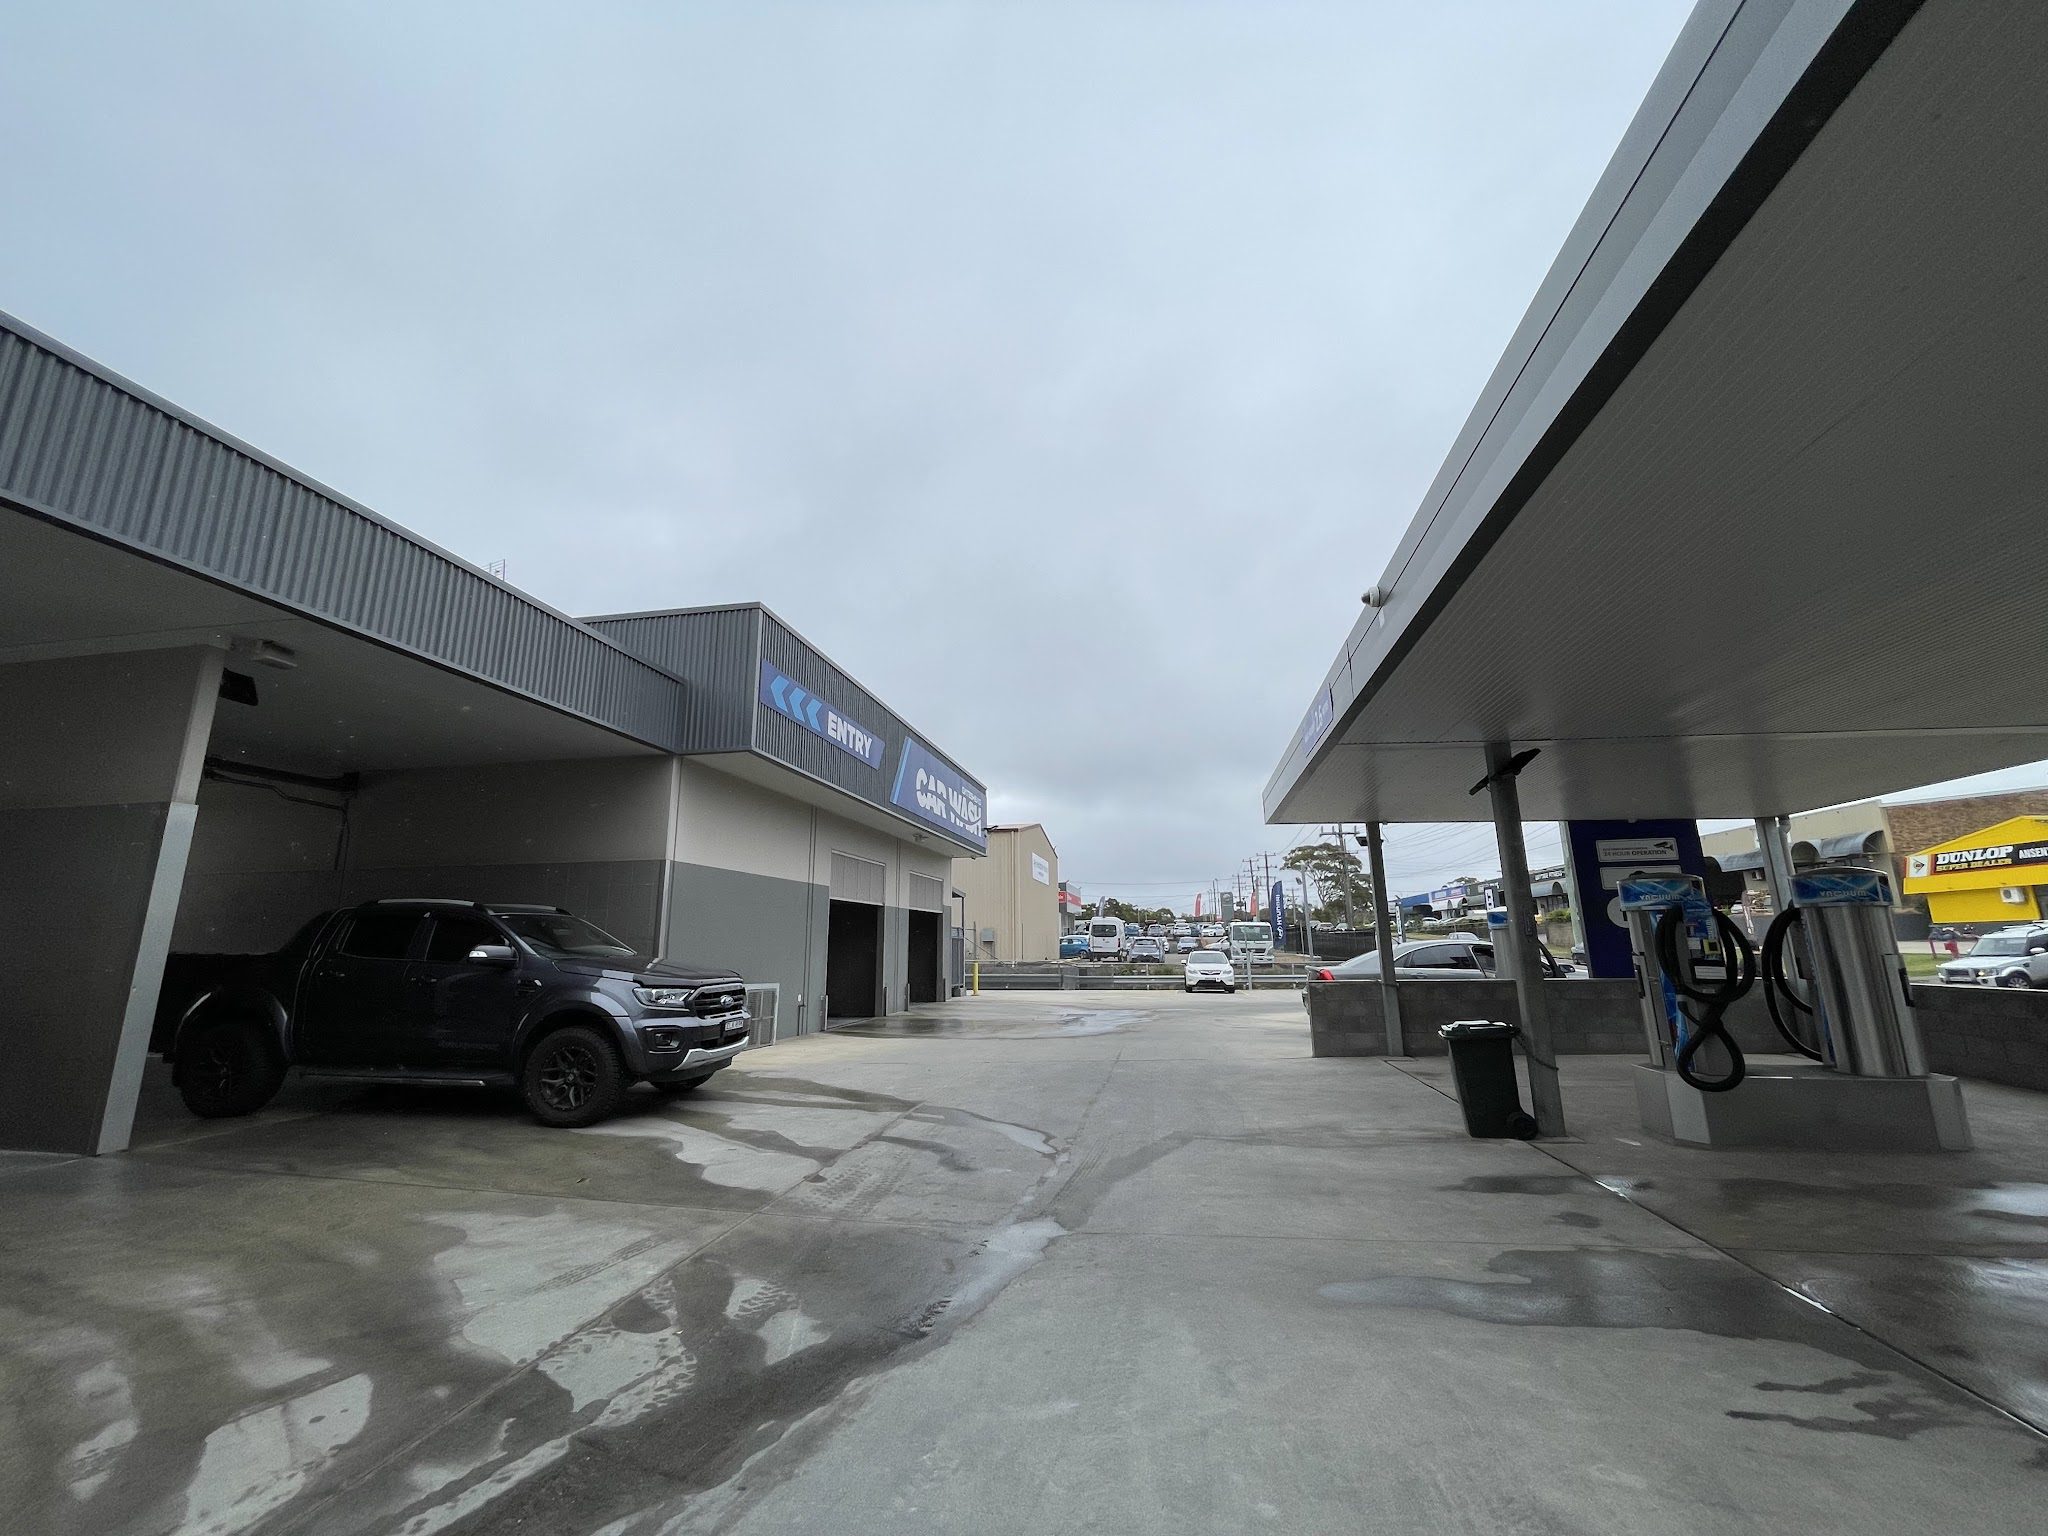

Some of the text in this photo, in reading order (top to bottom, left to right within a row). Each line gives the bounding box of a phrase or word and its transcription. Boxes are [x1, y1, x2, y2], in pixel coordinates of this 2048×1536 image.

[827, 711, 873, 758] ENTRY
[948, 787, 982, 825] WASH
[1936, 846, 2013, 864] DUNLOP
[1936, 858, 2012, 872] SUPER DEALER
[1275, 894, 1283, 926] HYUNDAI
